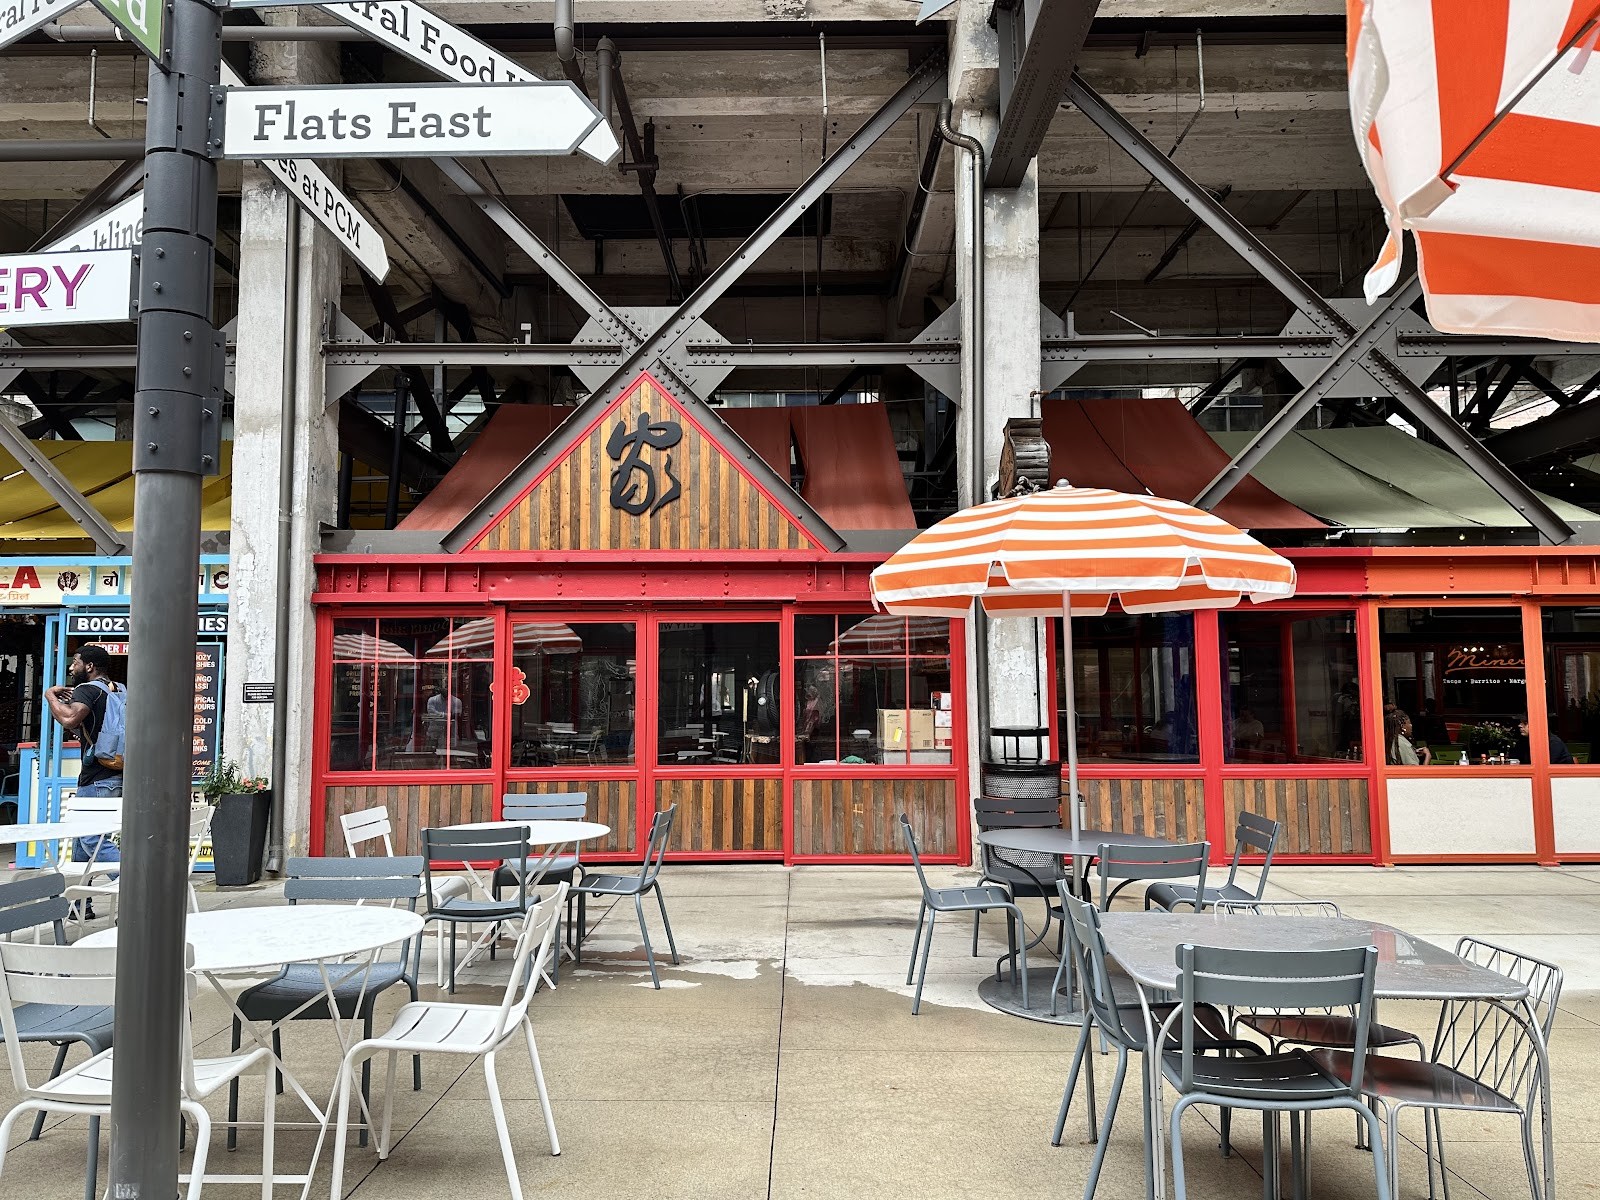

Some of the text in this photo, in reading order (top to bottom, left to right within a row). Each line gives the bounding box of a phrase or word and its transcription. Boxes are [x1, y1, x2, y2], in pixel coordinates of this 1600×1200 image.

[420, 19, 495, 82] Food
[253, 100, 493, 141] Flats East
[302, 174, 320, 206] at
[323, 186, 361, 249] PCM
[69, 217, 143, 252] ltline
[77, 617, 130, 632] BOOZ
